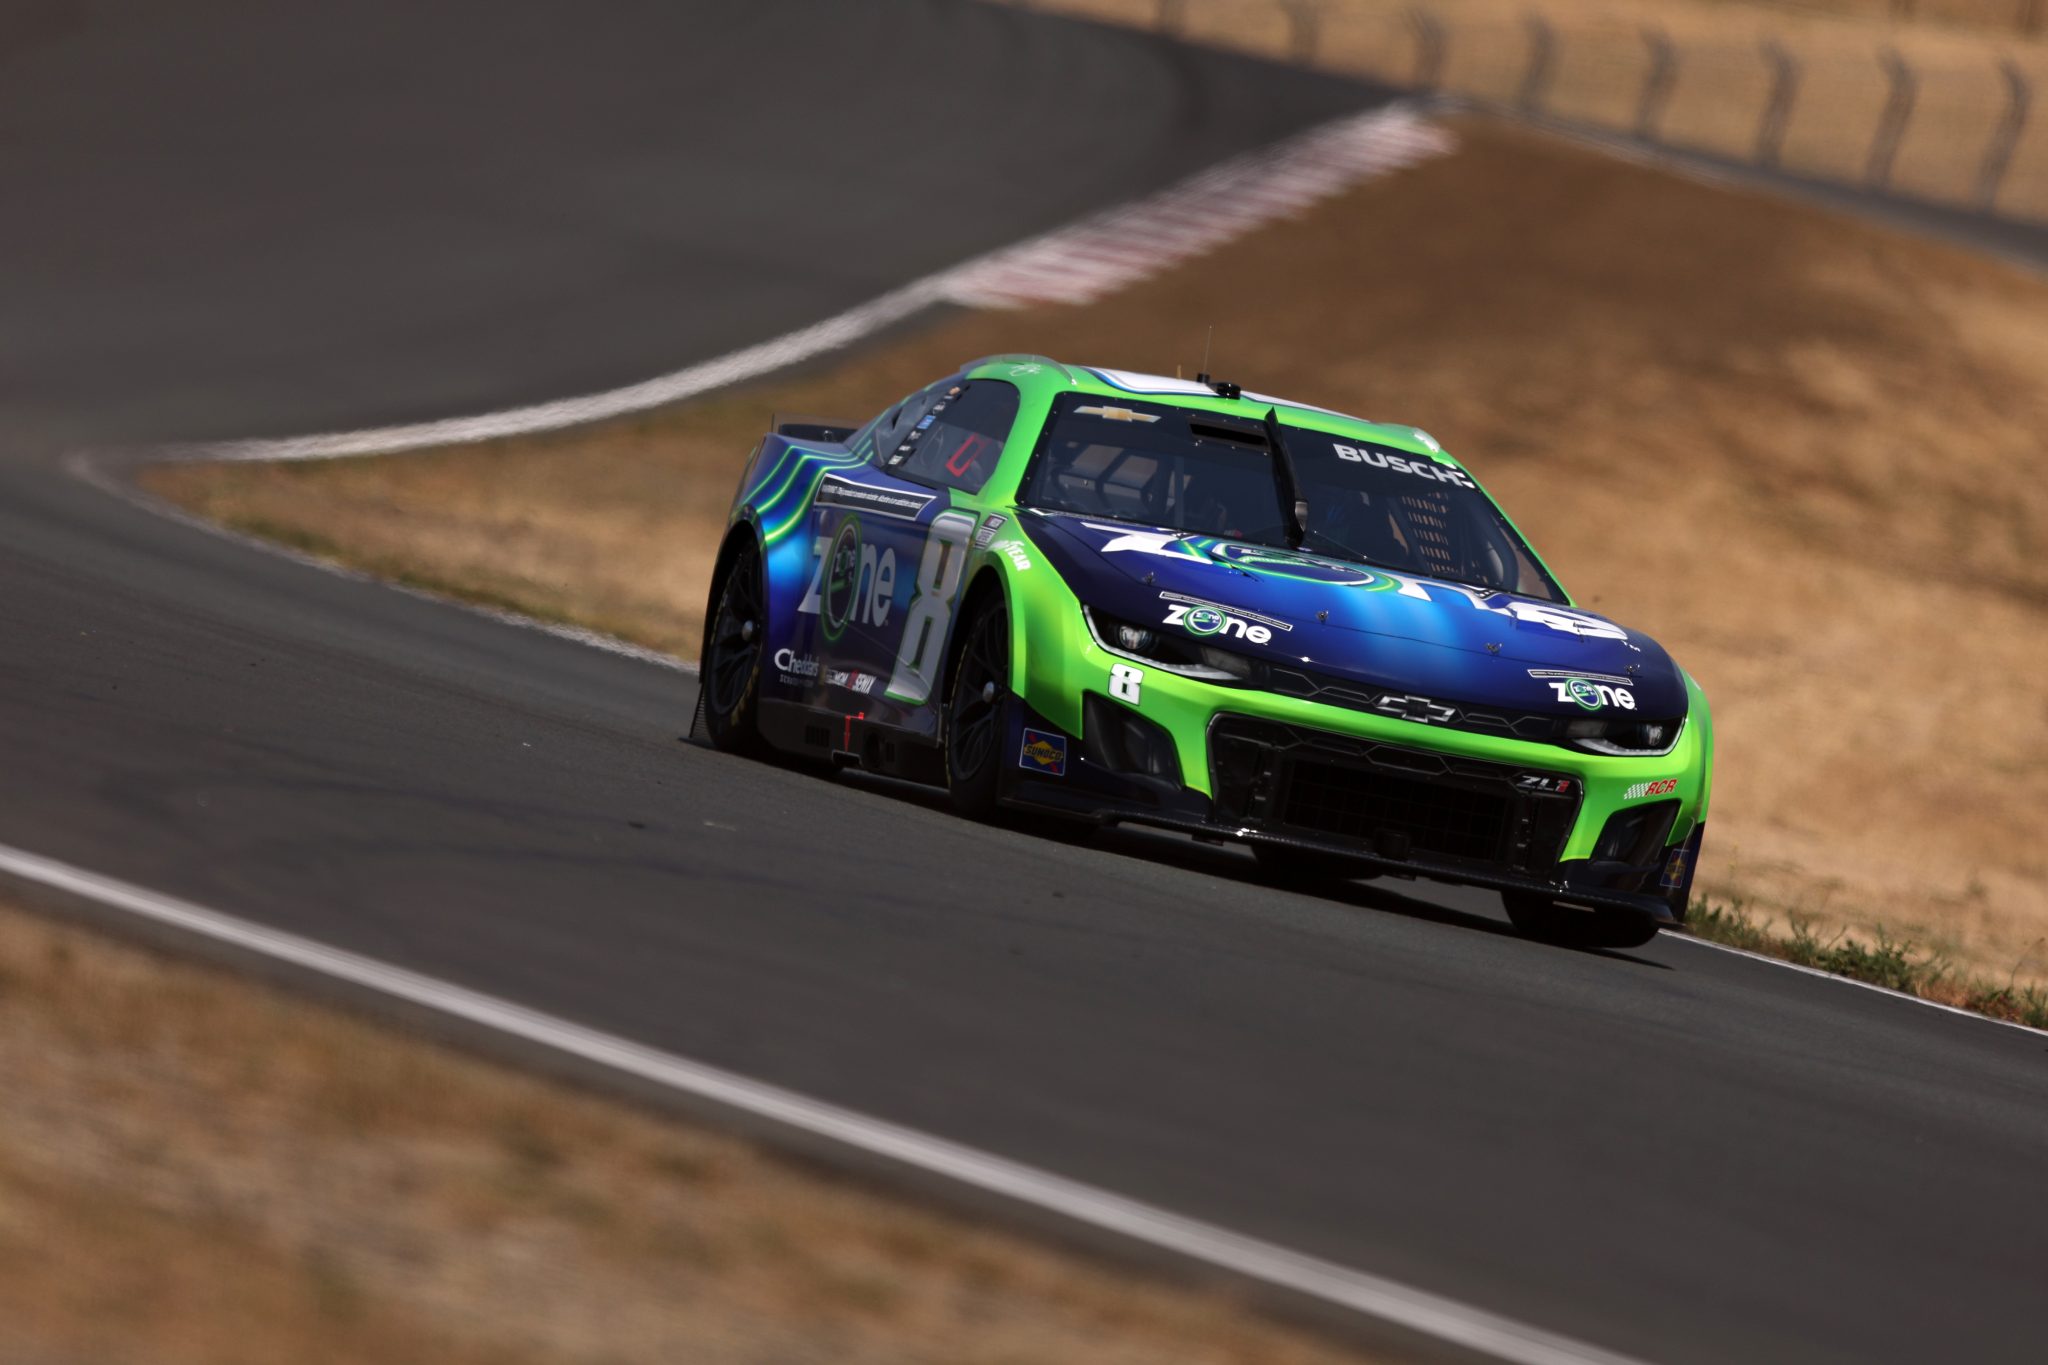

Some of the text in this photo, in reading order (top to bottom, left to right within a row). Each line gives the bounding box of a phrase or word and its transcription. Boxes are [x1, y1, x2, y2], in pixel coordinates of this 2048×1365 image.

[1333, 443, 1464, 487] BUSCH
[884, 510, 977, 705] 8
[1108, 662, 1145, 706] 8
[1516, 775, 1571, 793] ZL1
[1645, 779, 1678, 797] RCR
